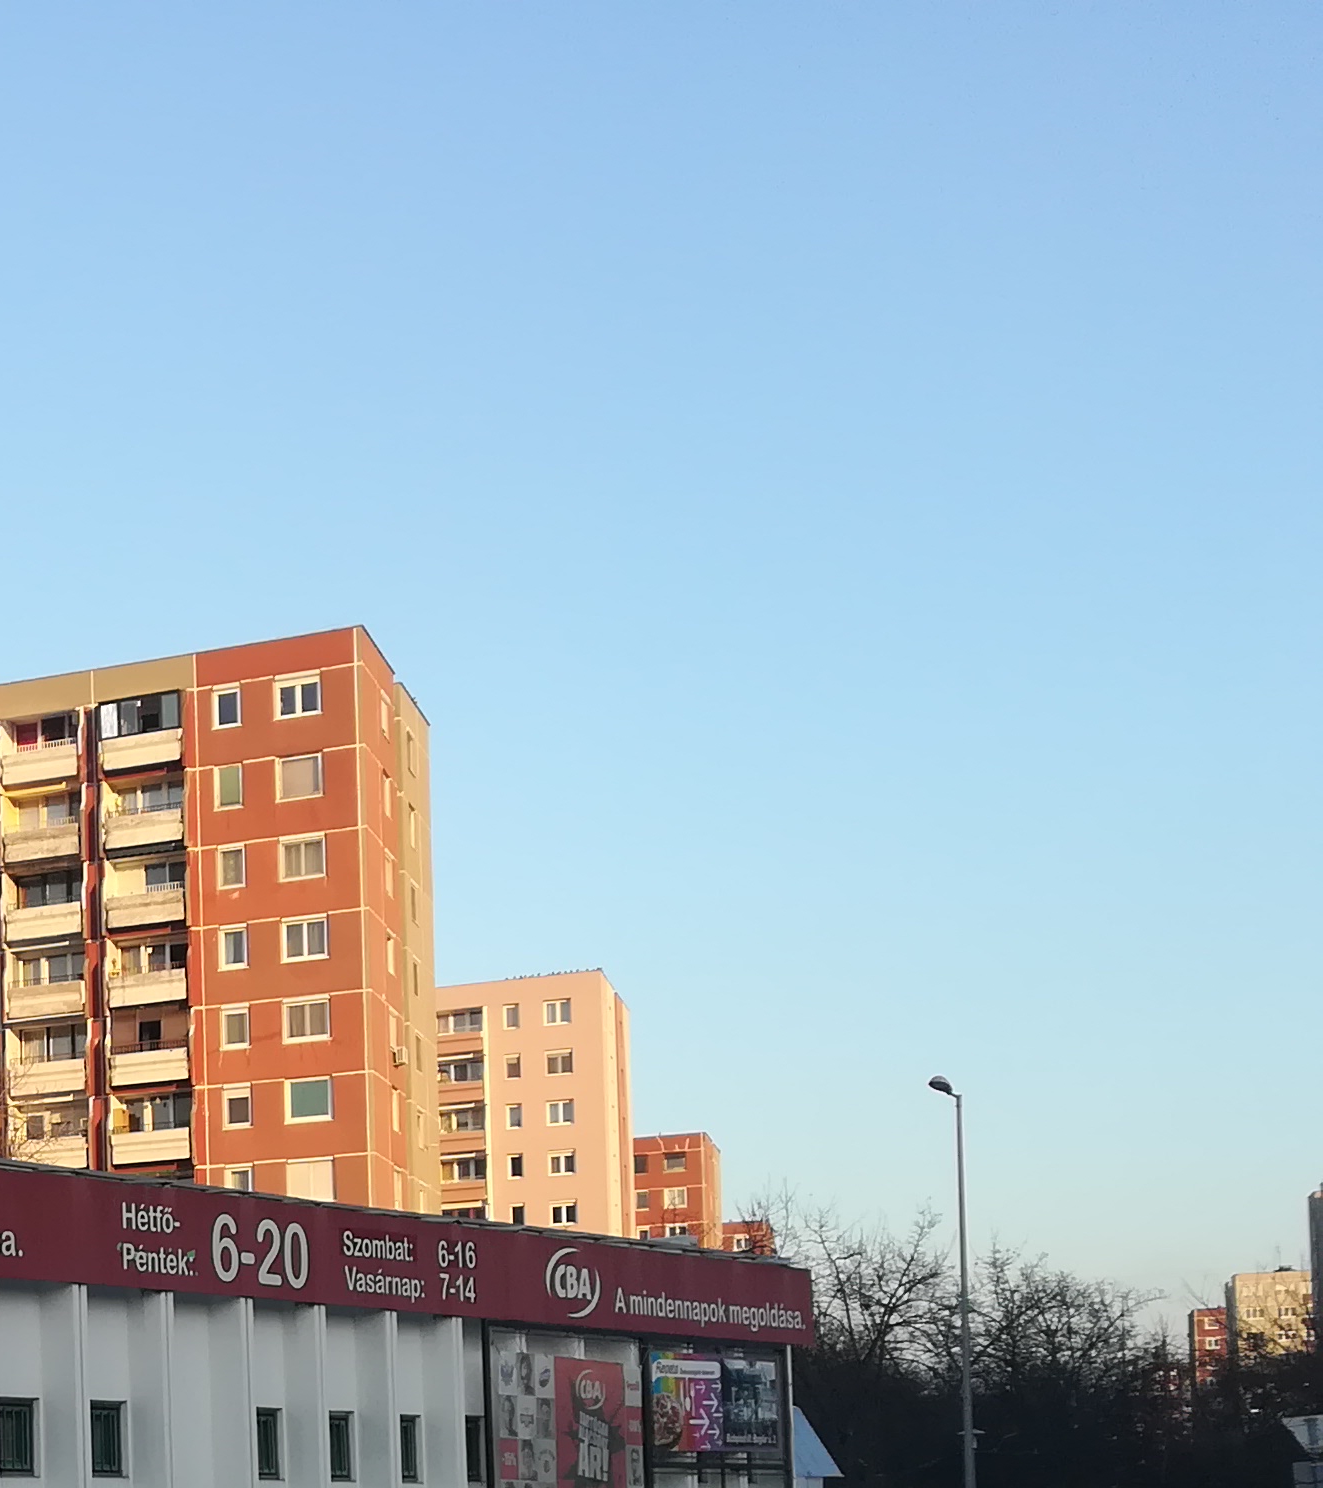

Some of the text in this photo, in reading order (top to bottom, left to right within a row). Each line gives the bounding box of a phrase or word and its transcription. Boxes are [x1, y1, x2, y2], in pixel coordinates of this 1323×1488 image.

[121, 1201, 181, 1235] Hétfő-
[211, 1213, 309, 1290] 6-20
[343, 1230, 477, 1269] Szombat: 6-16
[345, 1266, 477, 1303] Vasárnap: 7-14
[554, 1264, 592, 1301] CBA
[615, 1287, 806, 1332] A mindennapok megoldása.
[580, 1379, 602, 1400] CBA
